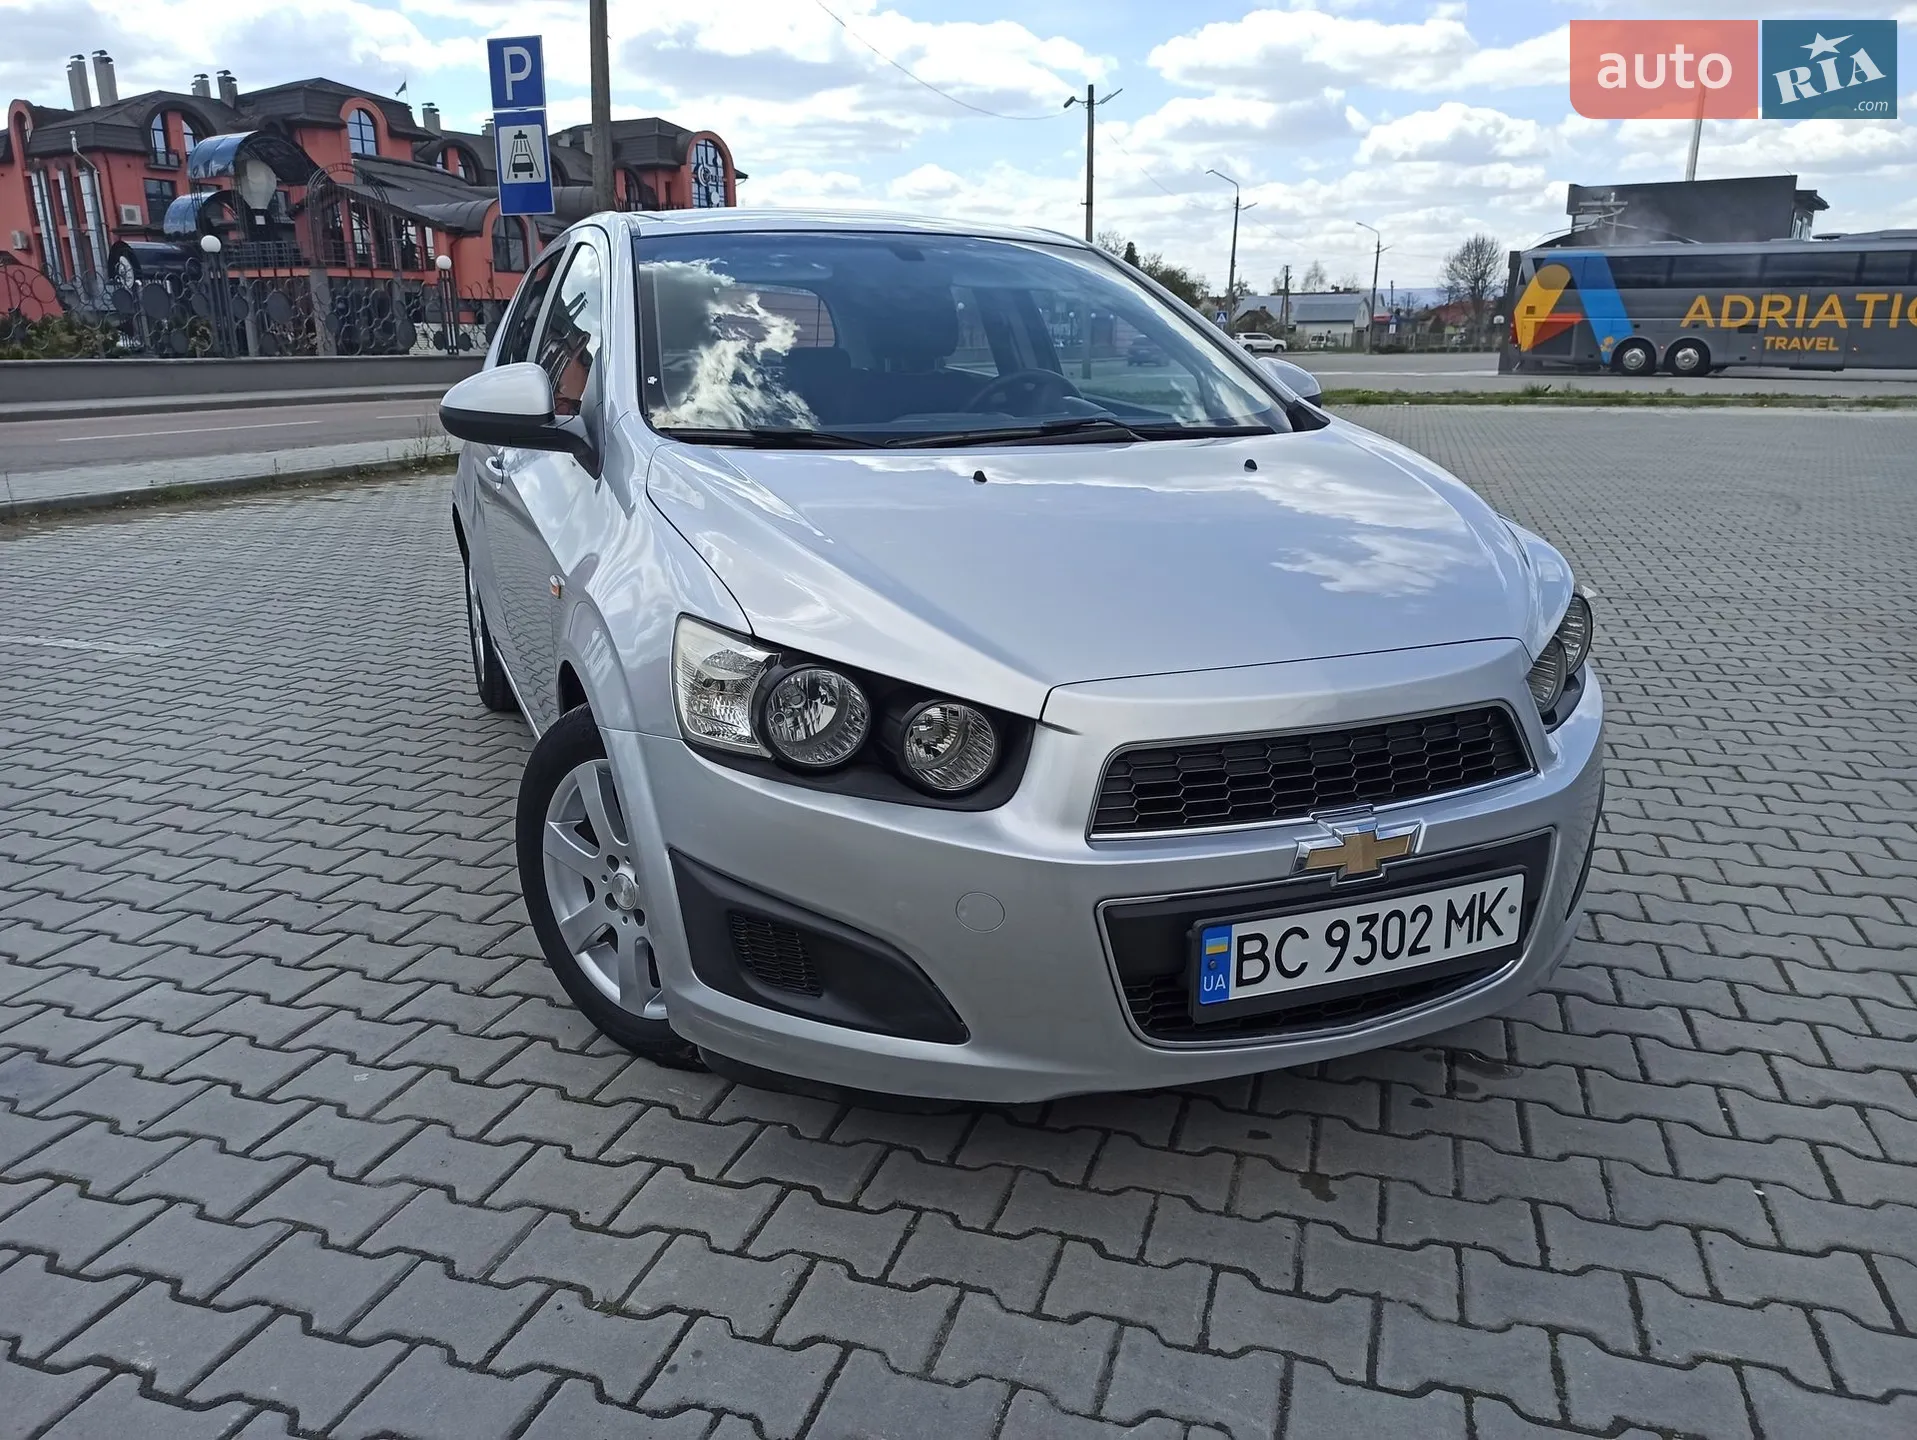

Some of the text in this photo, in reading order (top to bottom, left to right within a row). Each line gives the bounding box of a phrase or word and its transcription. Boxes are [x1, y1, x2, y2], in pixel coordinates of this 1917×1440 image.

[503, 46, 532, 101] P
[1764, 336, 1839, 351] TRAVEL
[1235, 887, 1509, 987] BC 9302 MK
[1203, 974, 1227, 992] UA
